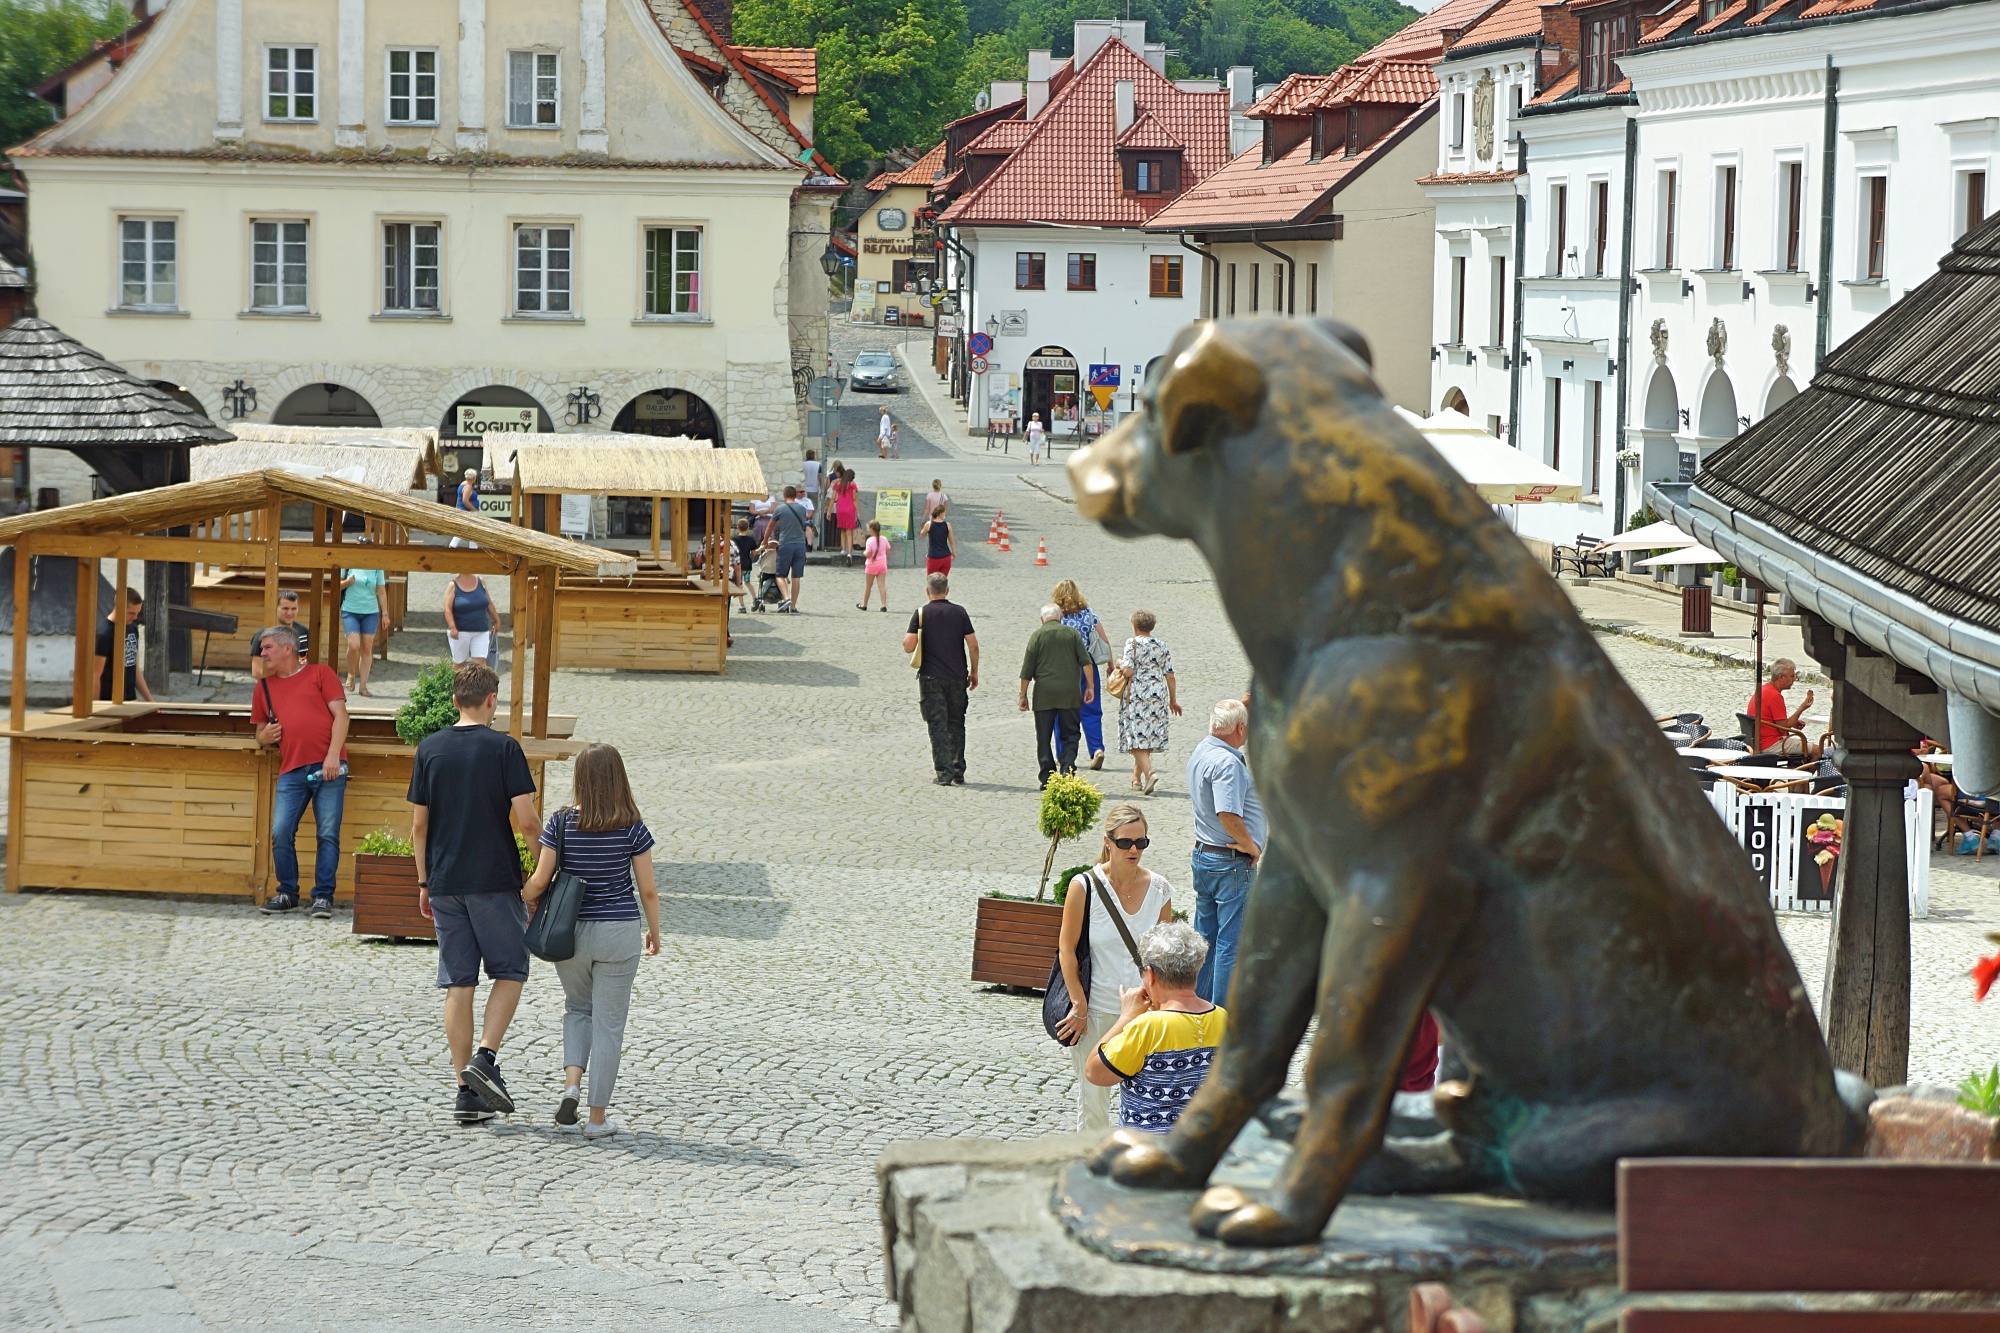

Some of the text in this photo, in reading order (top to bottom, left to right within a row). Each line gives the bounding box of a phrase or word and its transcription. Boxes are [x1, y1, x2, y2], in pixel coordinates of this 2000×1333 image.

[973, 360, 986, 370] 30
[1029, 359, 1075, 368] GALERIA
[463, 421, 532, 433] KOGUTY
[480, 500, 512, 511] OGUT
[1751, 808, 1766, 882] LOD
